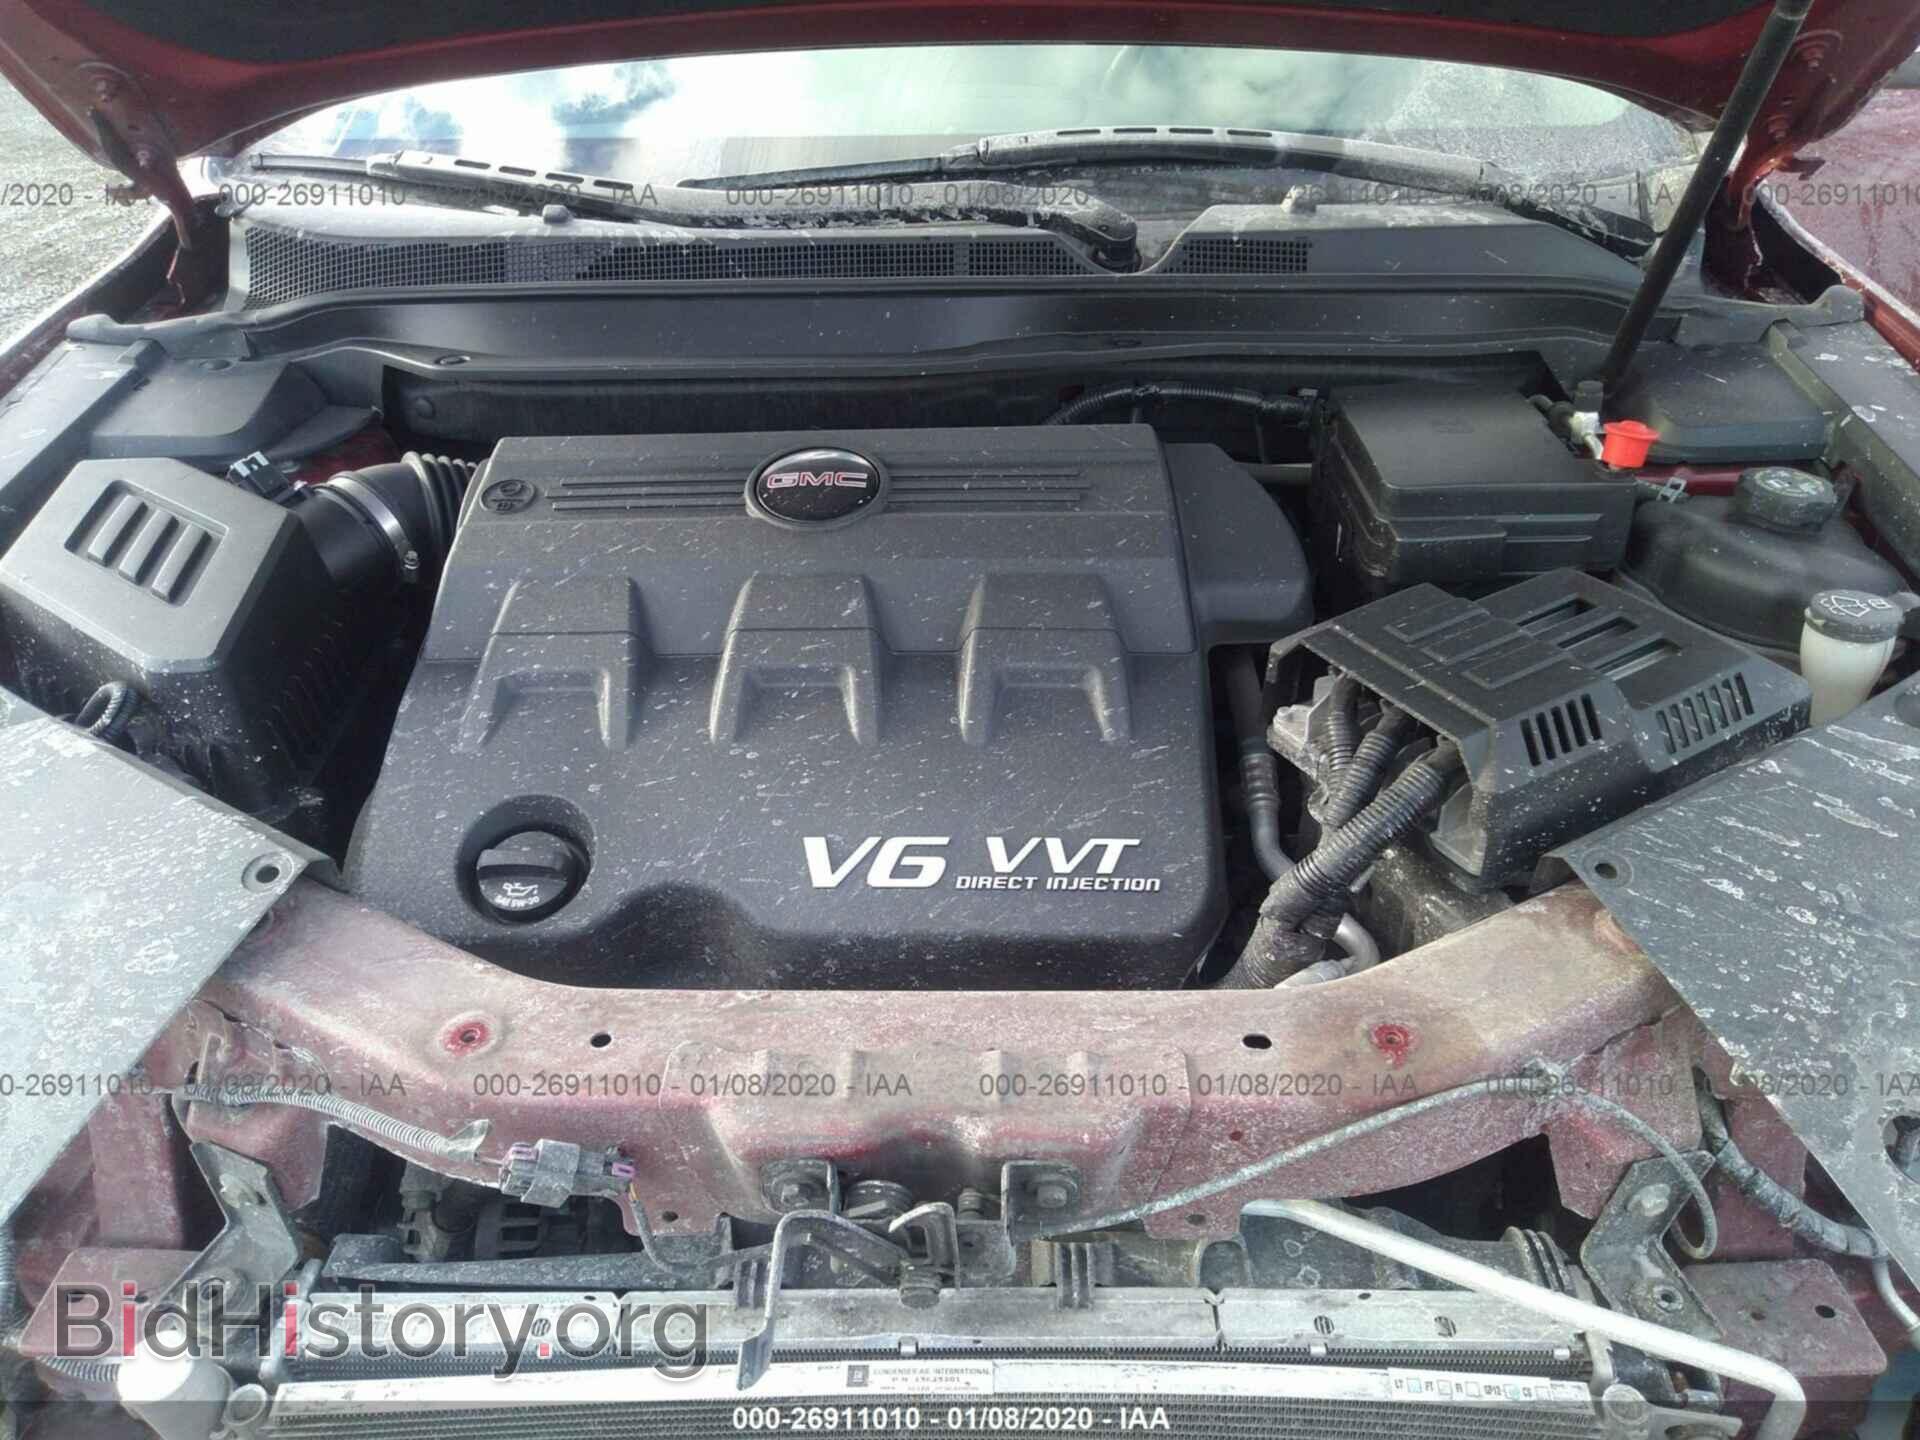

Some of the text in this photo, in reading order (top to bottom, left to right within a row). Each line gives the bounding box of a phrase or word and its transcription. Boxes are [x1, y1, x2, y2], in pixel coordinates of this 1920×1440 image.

[766, 472, 868, 488] GMC
[802, 836, 1141, 888] V6 VVT
[955, 876, 1160, 891] DIRECT INJECTION
